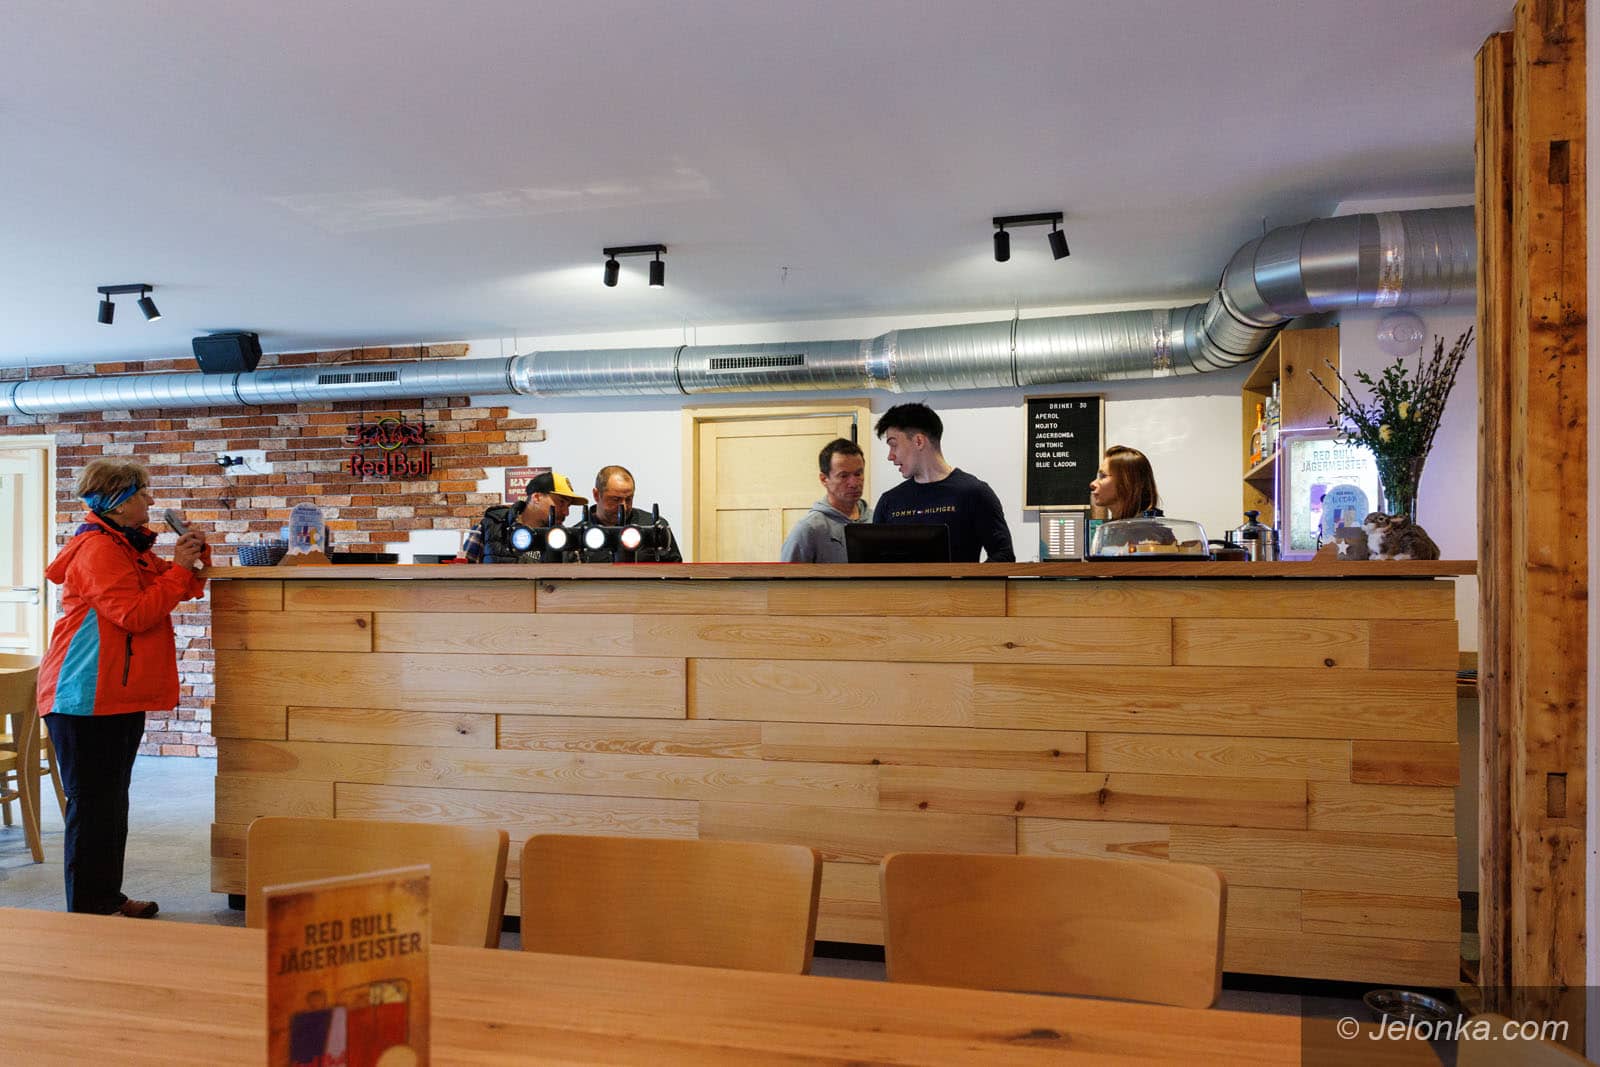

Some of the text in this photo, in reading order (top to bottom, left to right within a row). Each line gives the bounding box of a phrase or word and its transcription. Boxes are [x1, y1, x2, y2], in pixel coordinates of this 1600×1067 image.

[350, 451, 433, 475] Red Bull
[1313, 449, 1355, 461] RED BULL
[891, 506, 956, 518] TOMMY HILFIGER
[305, 913, 396, 945] RED BULL
[277, 932, 421, 975] JÄGERMEISTER
